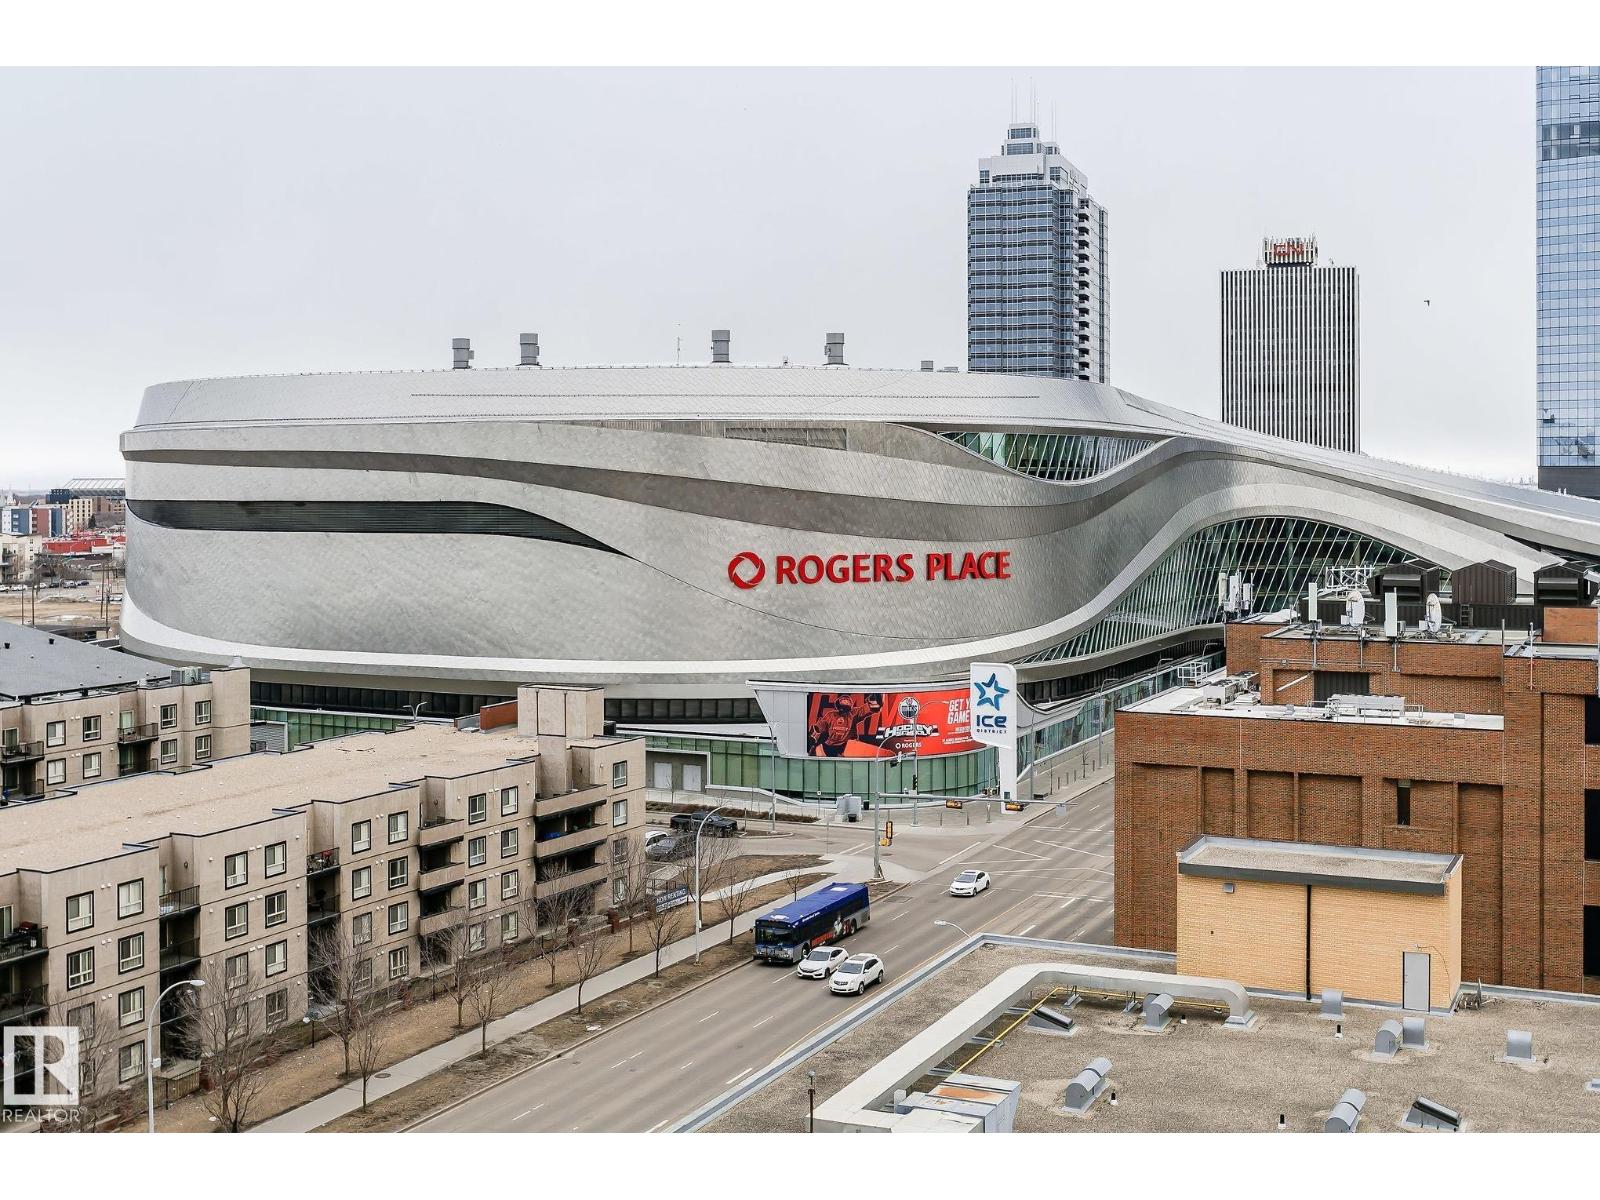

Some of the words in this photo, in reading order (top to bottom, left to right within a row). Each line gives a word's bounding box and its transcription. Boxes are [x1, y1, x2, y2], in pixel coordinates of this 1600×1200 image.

[776, 554, 915, 584] ROGERS
[926, 551, 1012, 581] PLACE
[948, 699, 964, 712] GET
[947, 710, 971, 724] GAME
